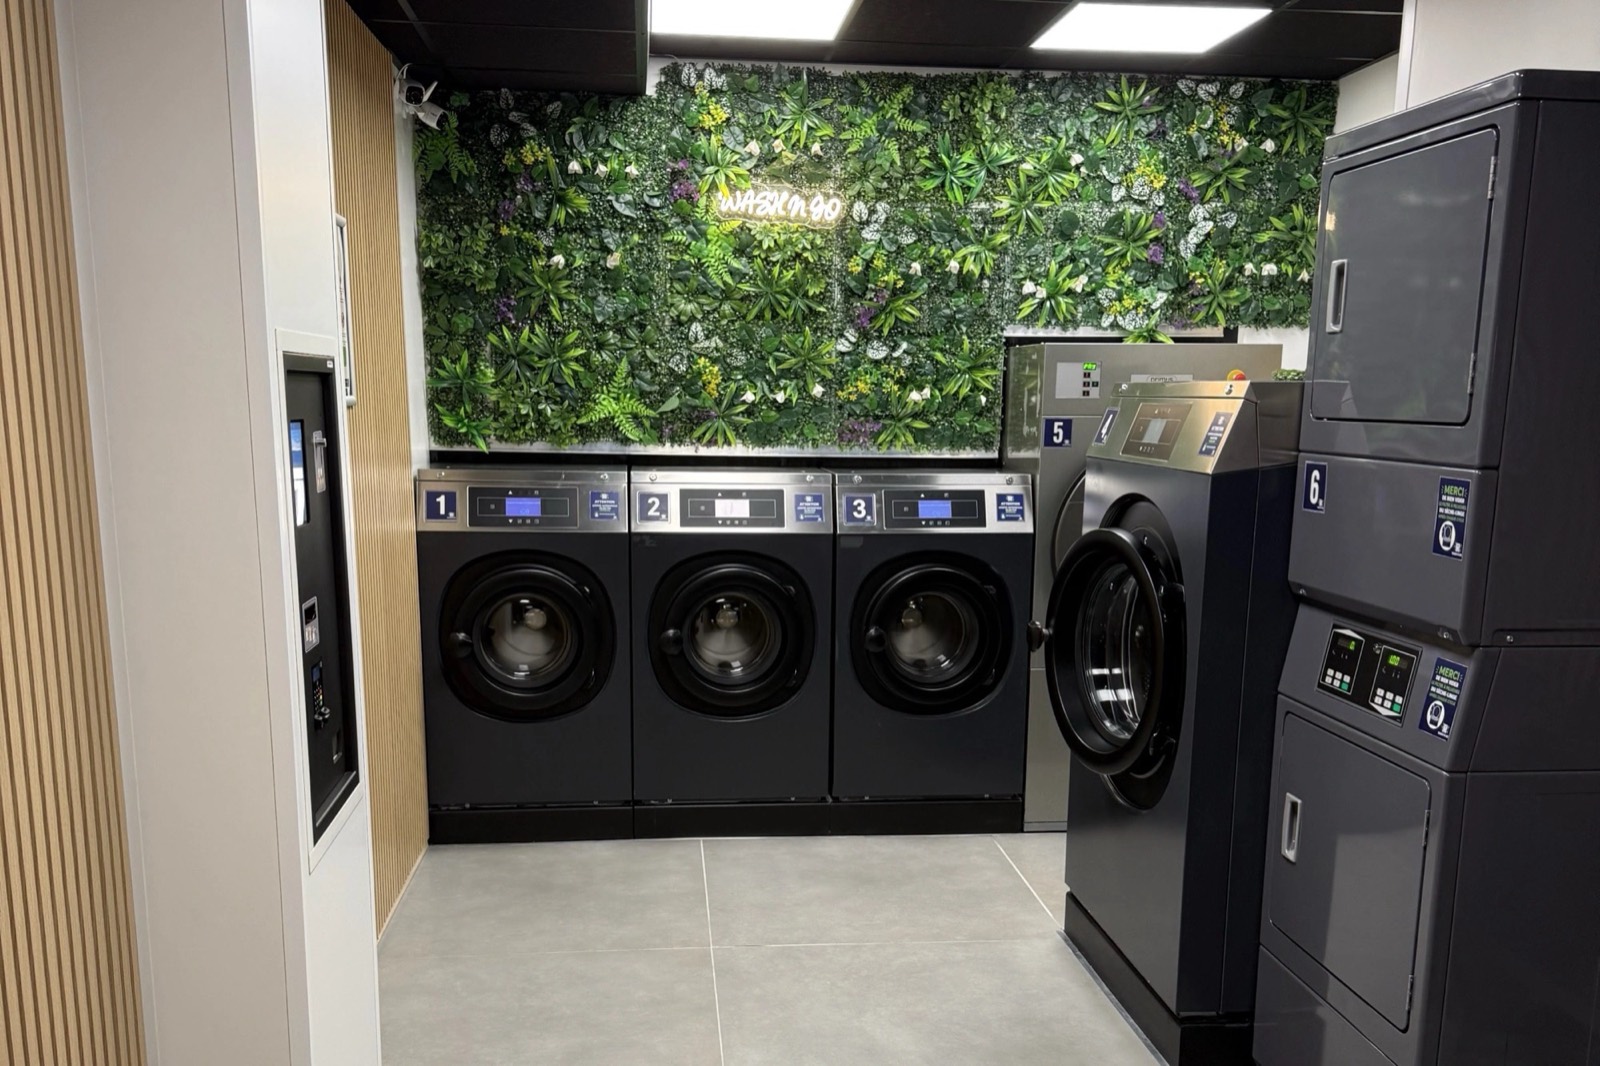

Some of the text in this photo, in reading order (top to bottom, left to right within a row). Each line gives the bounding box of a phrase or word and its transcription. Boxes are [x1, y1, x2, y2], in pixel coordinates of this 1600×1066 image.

[718, 189, 788, 216] WASH
[1053, 422, 1064, 444] 5
[1101, 414, 1112, 438] 4
[1310, 470, 1320, 504] 6
[1444, 485, 1464, 497] MERCI
[436, 494, 445, 515] 1
[648, 497, 660, 516] 2
[853, 499, 866, 518] 3
[1439, 666, 1460, 680] MERCI
